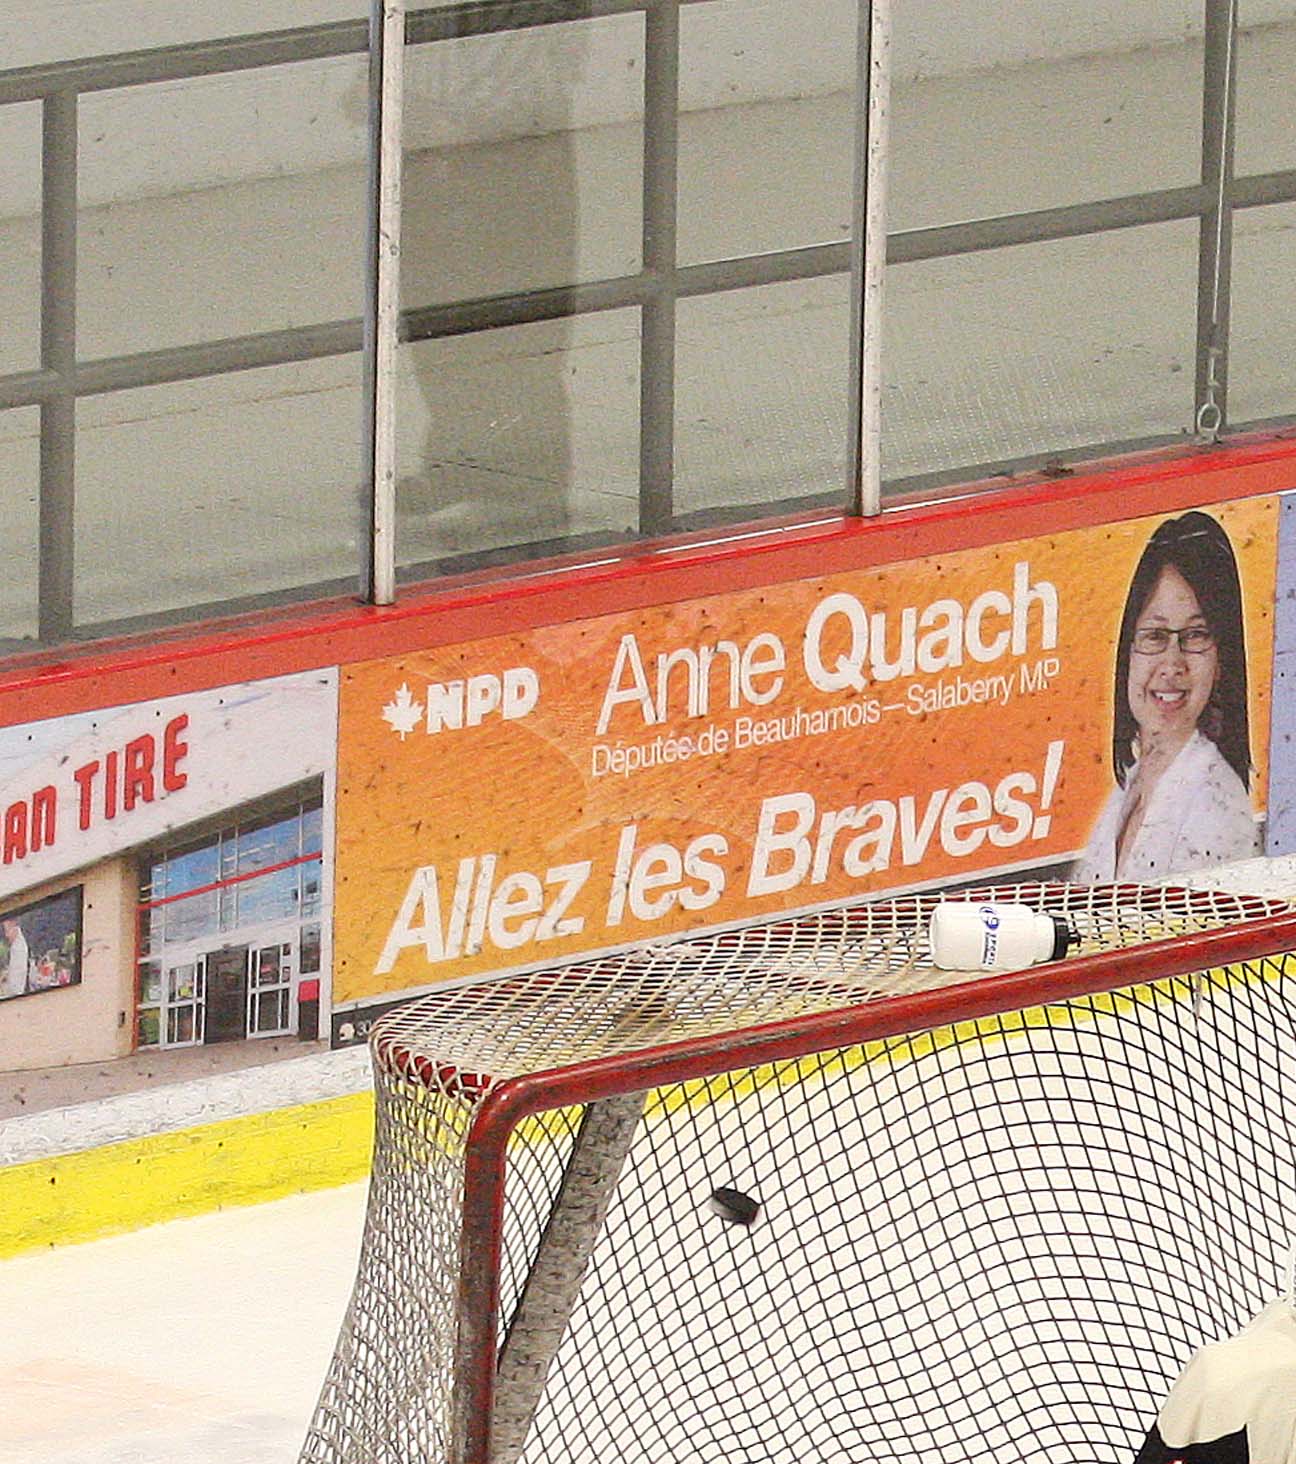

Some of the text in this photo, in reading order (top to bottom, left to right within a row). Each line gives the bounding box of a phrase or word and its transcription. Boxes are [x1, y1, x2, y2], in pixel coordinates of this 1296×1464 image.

[426, 667, 540, 735] NPD
[595, 562, 1059, 736] Anne Quach
[74, 713, 188, 830] TIRE
[591, 731, 694, 778] Députée
[698, 725, 730, 757] de
[373, 741, 1065, 975] Allez les Braves!
